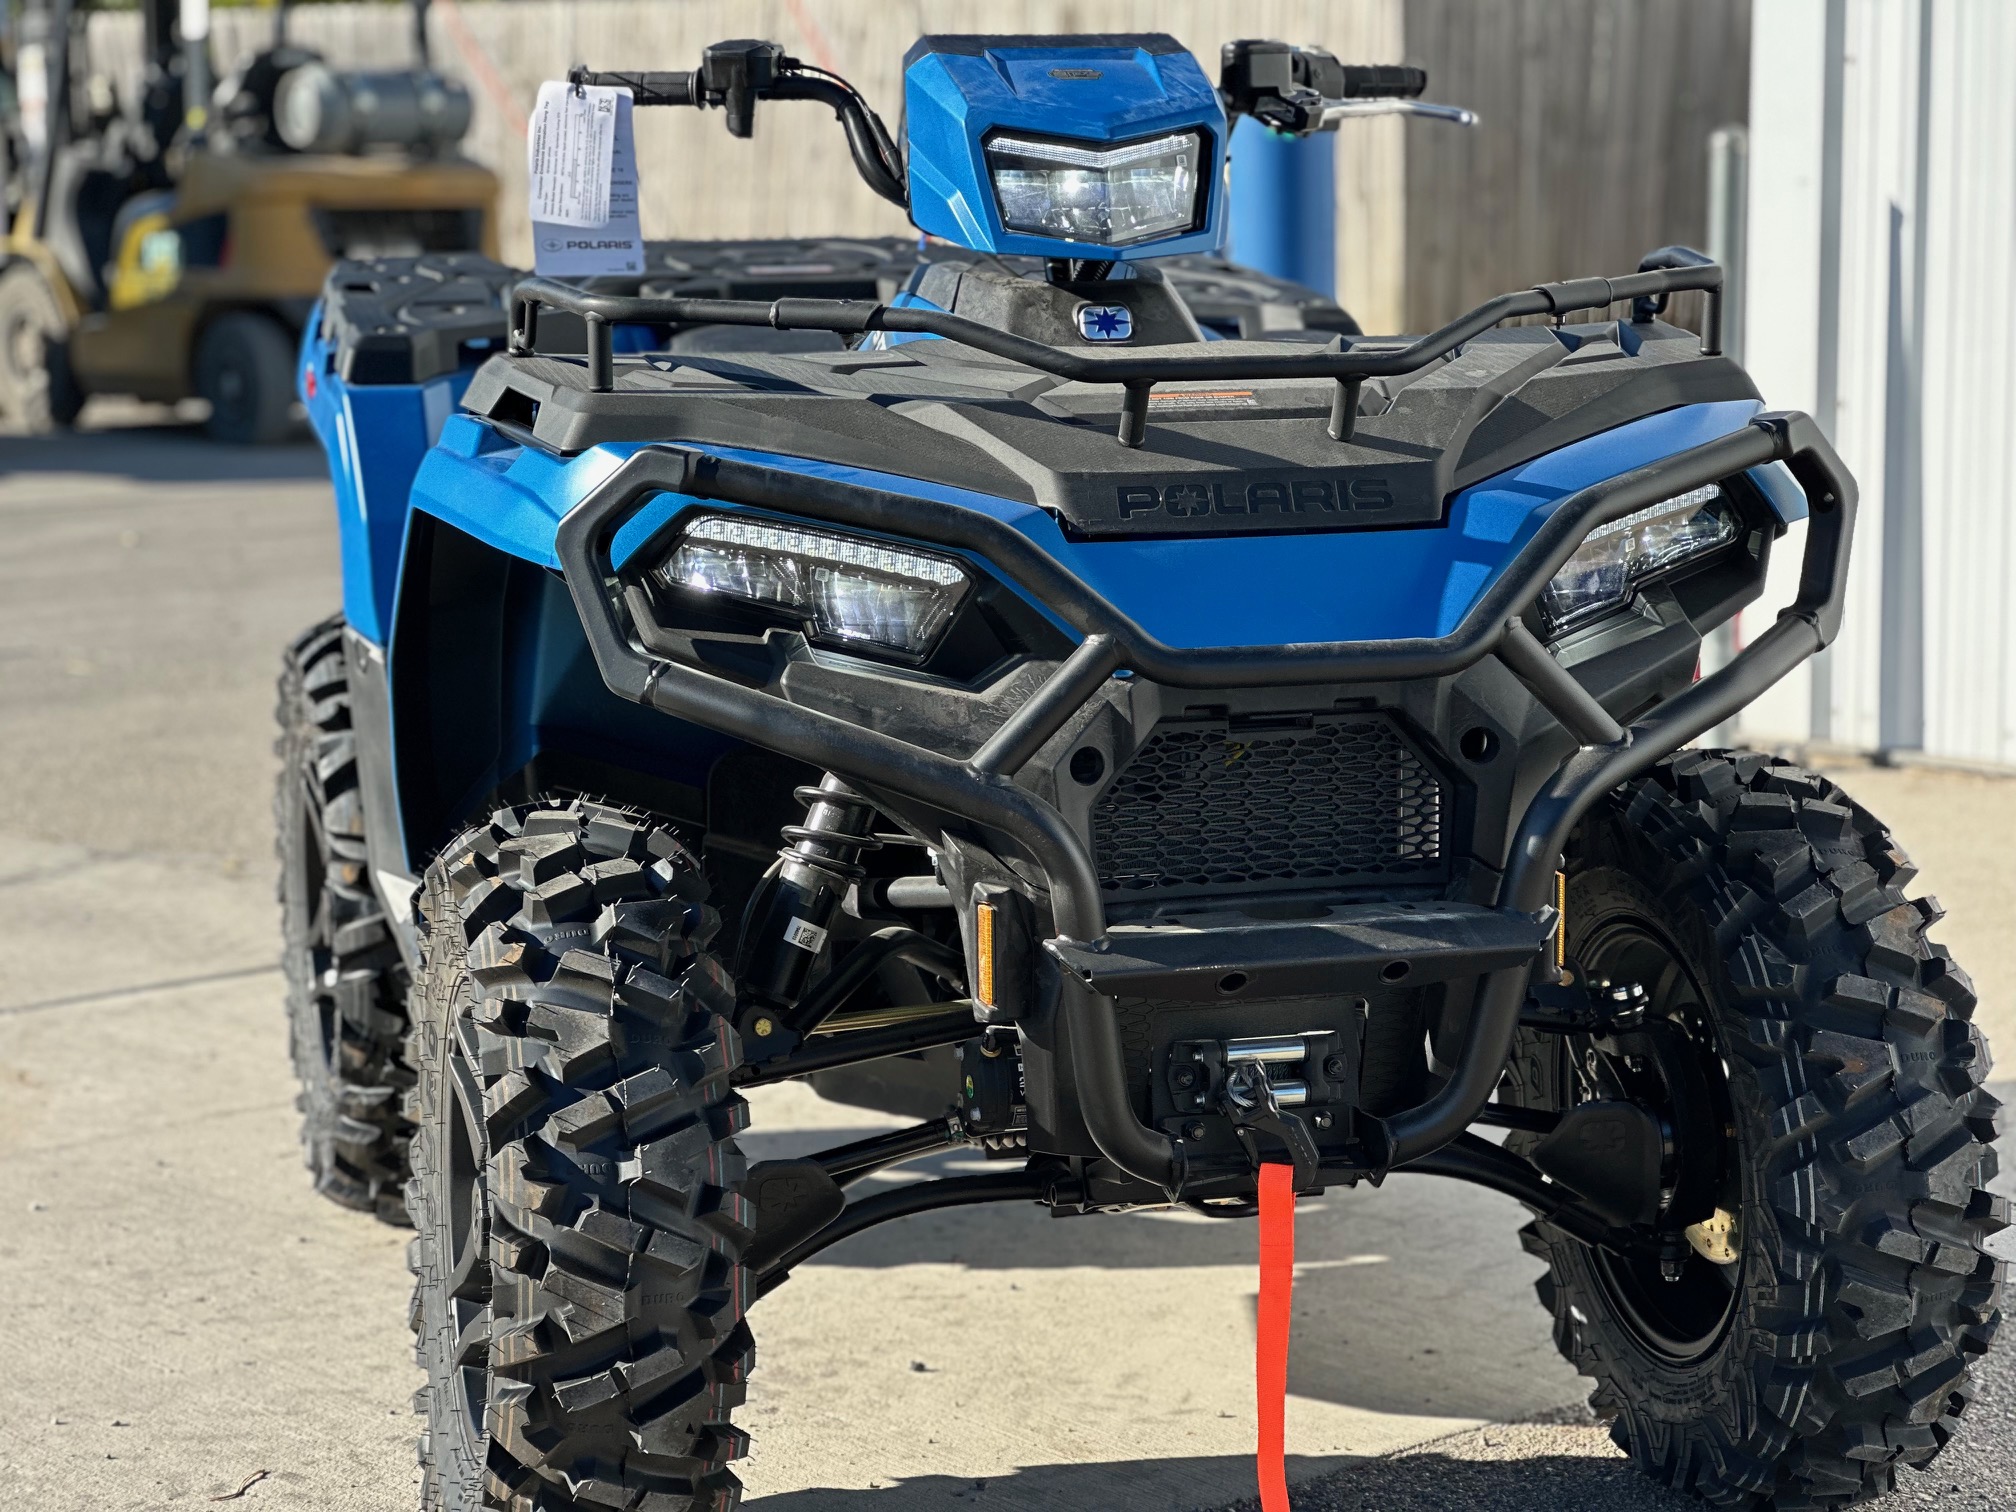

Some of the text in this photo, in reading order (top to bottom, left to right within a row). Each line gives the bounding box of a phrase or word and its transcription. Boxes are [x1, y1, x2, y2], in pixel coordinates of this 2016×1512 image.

[566, 241, 633, 250] POLARIS
[1116, 479, 1394, 520] POLARIS
[1900, 1051, 1936, 1063] DURO
[641, 1291, 685, 1306] DURO
